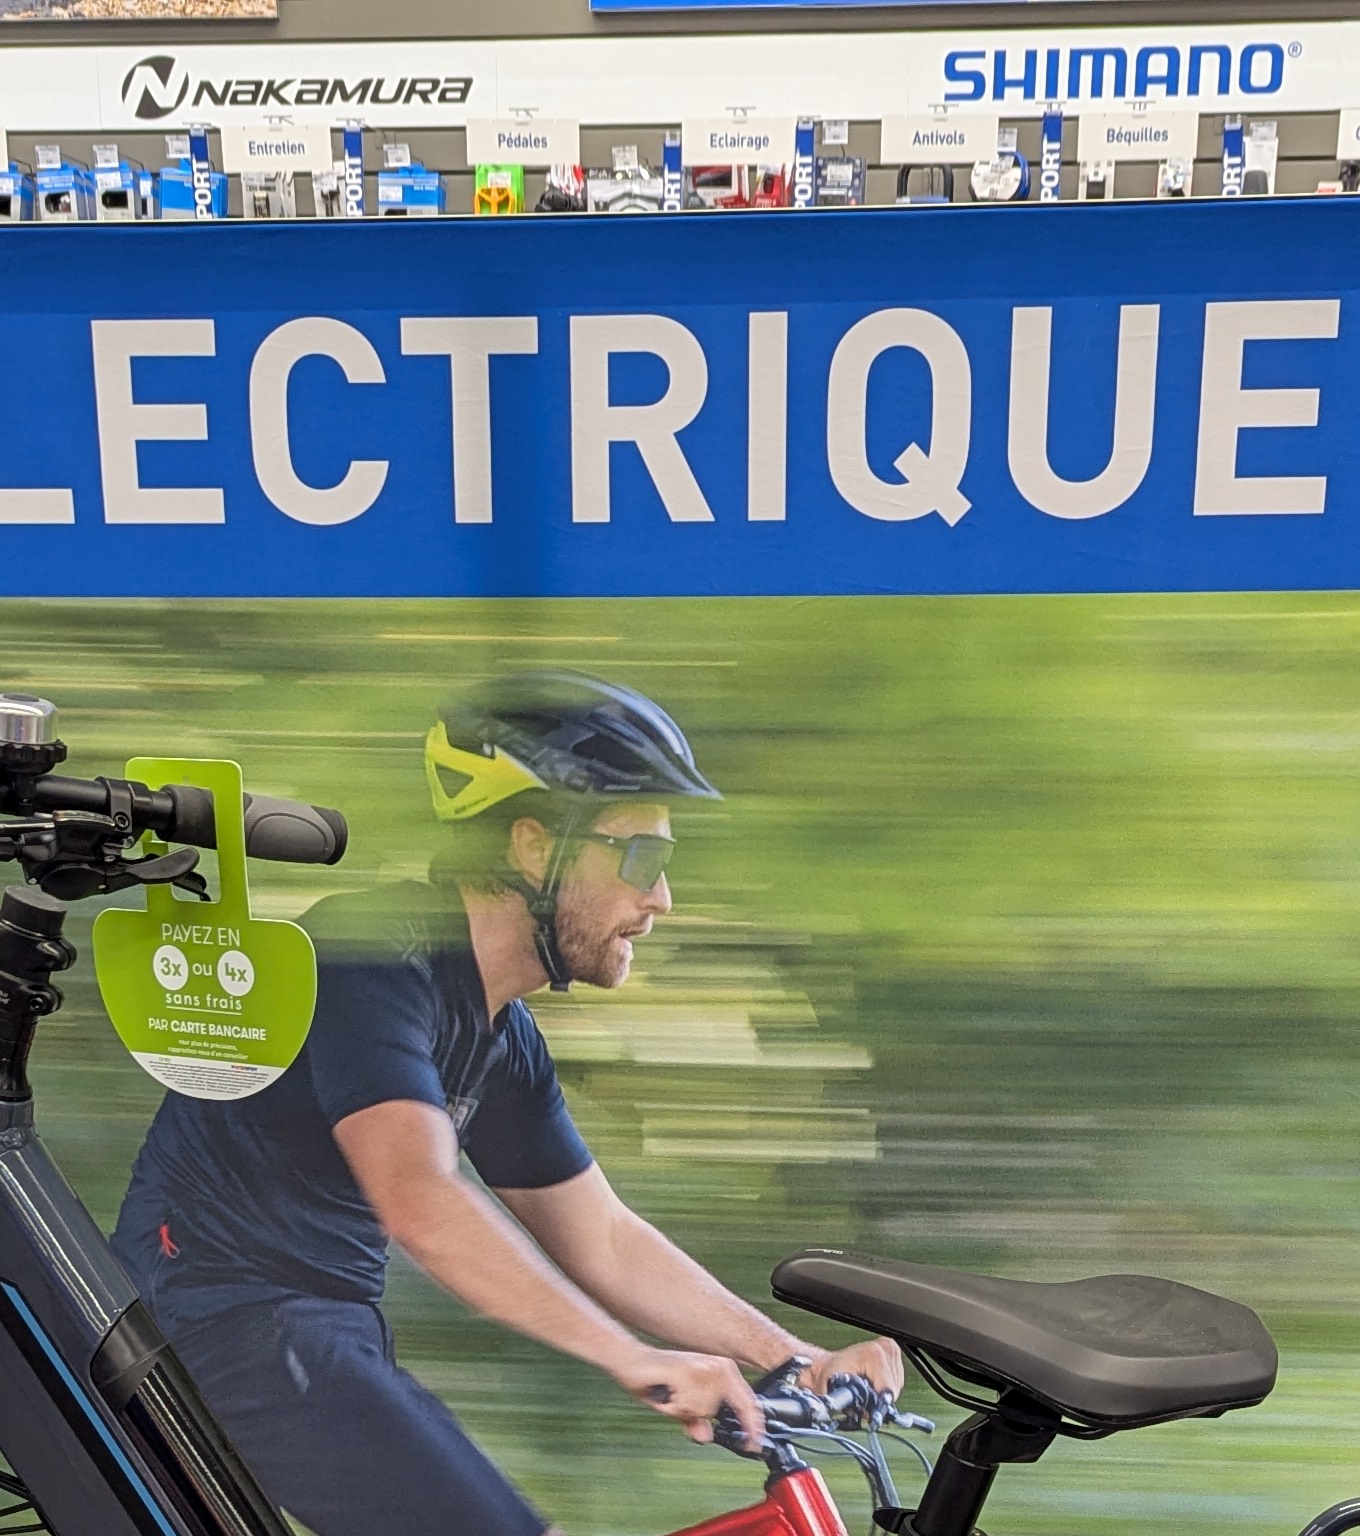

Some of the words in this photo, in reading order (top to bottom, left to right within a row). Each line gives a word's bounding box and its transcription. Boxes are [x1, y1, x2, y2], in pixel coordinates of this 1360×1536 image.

[944, 42, 1284, 101] SHIMANO
[191, 76, 473, 106] NAKAMURA
[498, 132, 548, 149] Pédales
[709, 133, 770, 151] Eclairage
[912, 130, 965, 147] Antivols
[1106, 127, 1169, 146] Béquilles
[248, 139, 306, 157] Entretien
[162, 923, 213, 945] PAYEZ
[218, 928, 240, 947] EN
[160, 957, 182, 977] 3x
[193, 964, 212, 977] ou
[225, 963, 248, 983] 4x
[166, 992, 200, 1007] sans
[206, 994, 242, 1010] frais
[149, 1017, 169, 1031] PAR
[171, 1020, 207, 1035] CARTE
[208, 1023, 267, 1041] BANCAIRE
